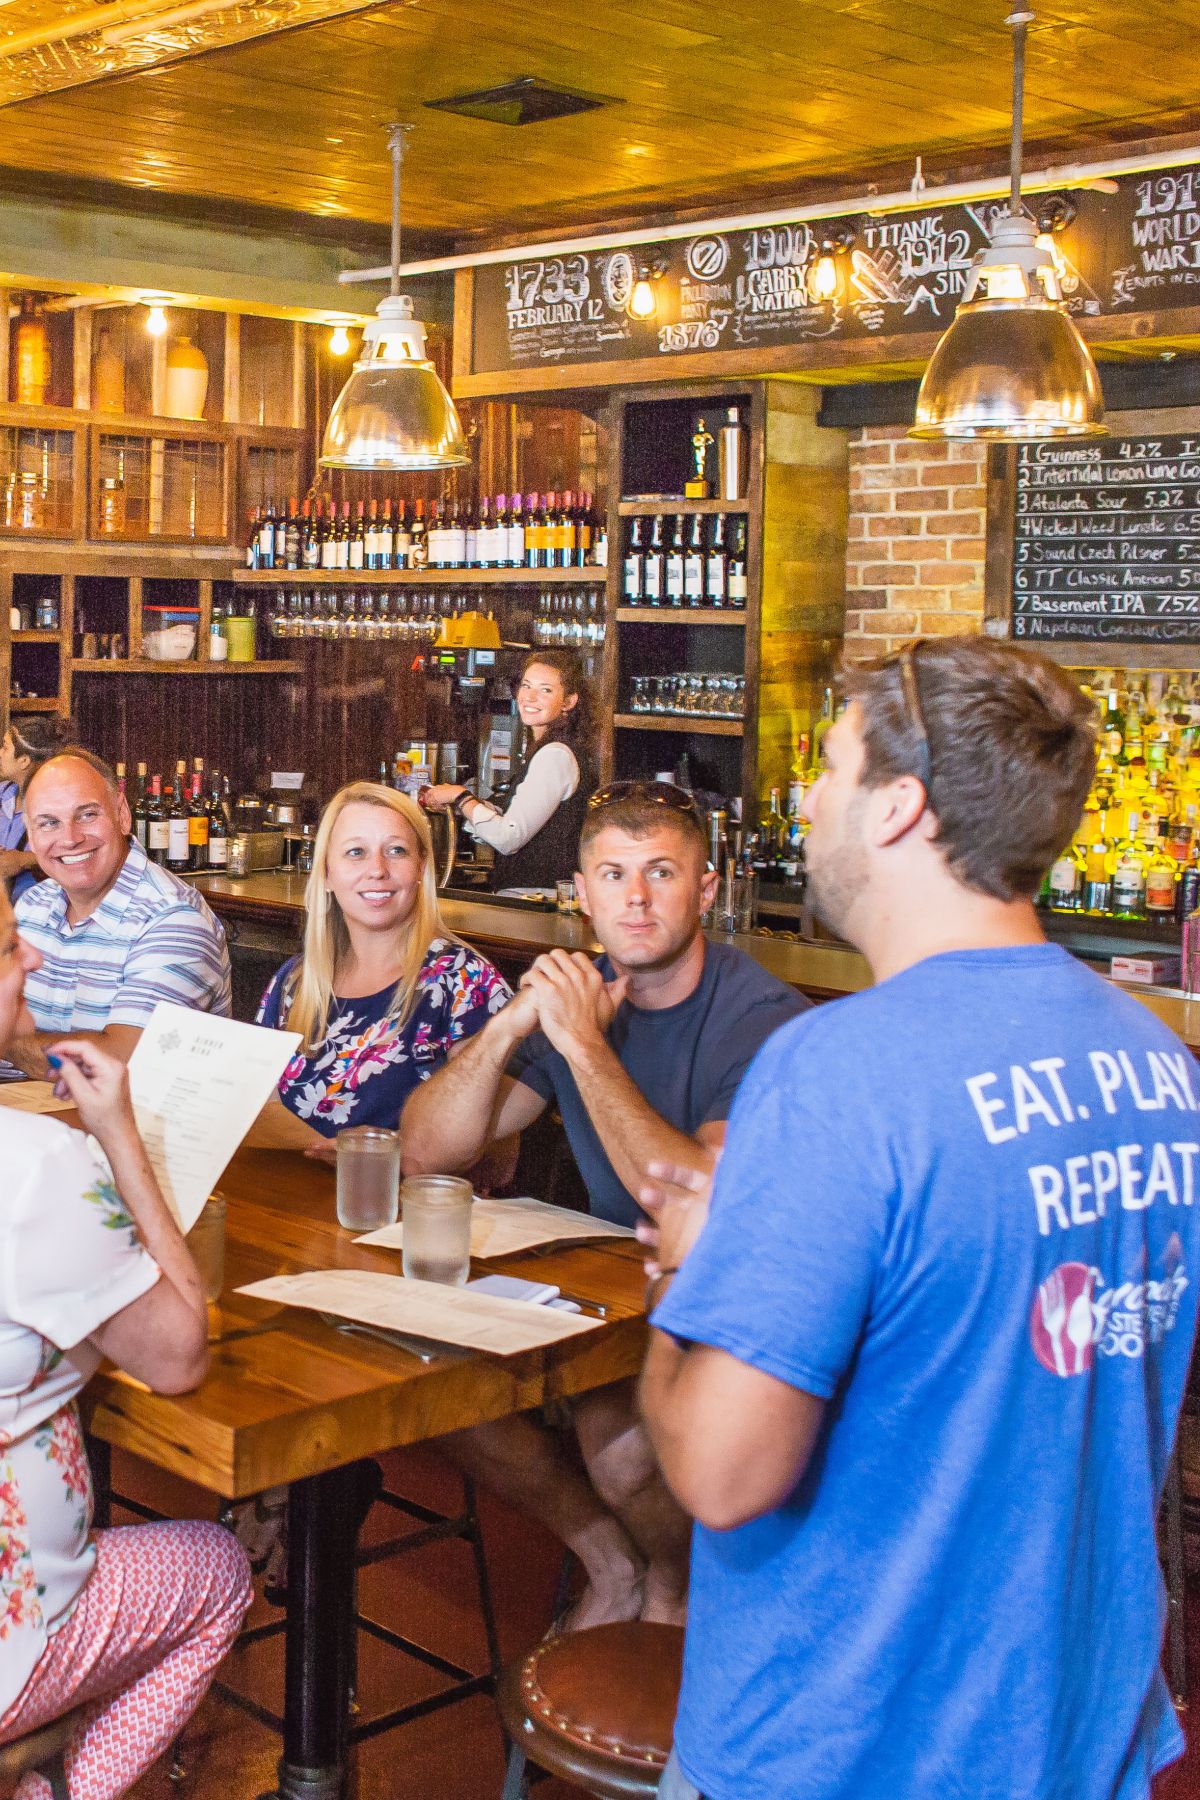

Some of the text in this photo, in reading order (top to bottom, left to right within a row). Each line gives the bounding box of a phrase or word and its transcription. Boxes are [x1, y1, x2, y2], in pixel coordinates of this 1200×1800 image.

[863, 216, 945, 249] TITANIC
[1131, 211, 1200, 247] WORLD
[744, 222, 811, 270] 1900
[898, 229, 973, 277] 1912
[1141, 245, 1190, 273] WAR
[504, 254, 591, 311] 1733
[748, 264, 809, 297] CARRY
[506, 298, 605, 330] FEBRUARY 12
[751, 288, 809, 313] NATION
[658, 319, 720, 352] 1876
[1019, 445, 1029, 464] 1
[1035, 443, 1102, 464] Guinness
[1018, 467, 1032, 488] 2
[1017, 492, 1029, 513] 3
[1096, 490, 1129, 509] Sour
[1019, 517, 1031, 536] 4
[1030, 517, 1078, 537] Wicked
[1079, 516, 1116, 535] Weed
[1017, 542, 1031, 563] 5
[1015, 567, 1028, 589] 6
[1066, 567, 1120, 587] Classic
[1016, 595, 1029, 612] 7
[1030, 593, 1109, 613] Basement
[1110, 592, 1146, 614] IPA
[1014, 616, 1026, 636] 8
[965, 1056, 1091, 1145] EAT.
[1027, 1141, 1200, 1237] REPEAT
